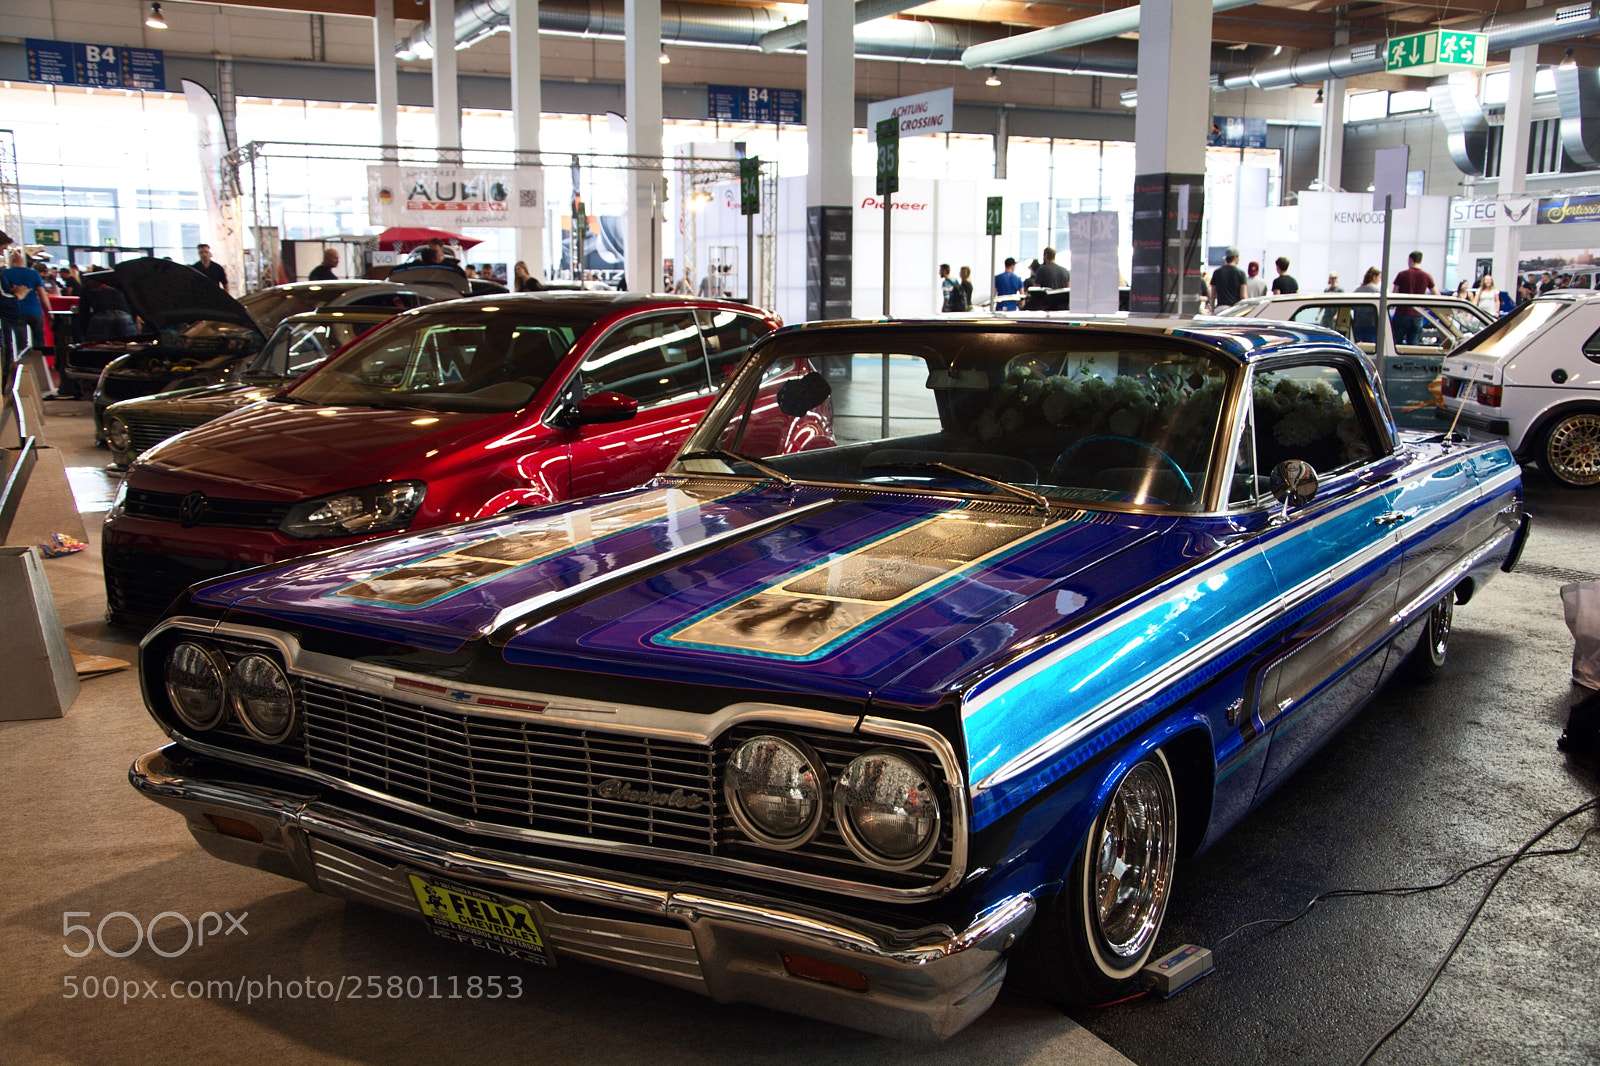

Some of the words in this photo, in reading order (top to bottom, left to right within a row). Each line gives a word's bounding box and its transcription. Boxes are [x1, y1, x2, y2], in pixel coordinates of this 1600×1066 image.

[85, 45, 116, 64] B4
[748, 87, 769, 102] B4
[891, 102, 929, 117] ACHTUNG
[900, 114, 944, 132] CROSSING
[878, 144, 895, 173] 35
[742, 177, 757, 198] 34
[407, 202, 507, 211] SYSTEM
[1454, 203, 1496, 220] STEG
[988, 209, 999, 224] 21
[1334, 211, 1385, 224] KENWOOD
[597, 778, 703, 809] Chevrolet
[448, 893, 534, 933] FELIX
[458, 915, 538, 943] CHEVROLET
[458, 924, 493, 940] FIGUEROA
[501, 936, 543, 953] JEFFERSON
[457, 934, 522, 960] FELIX
